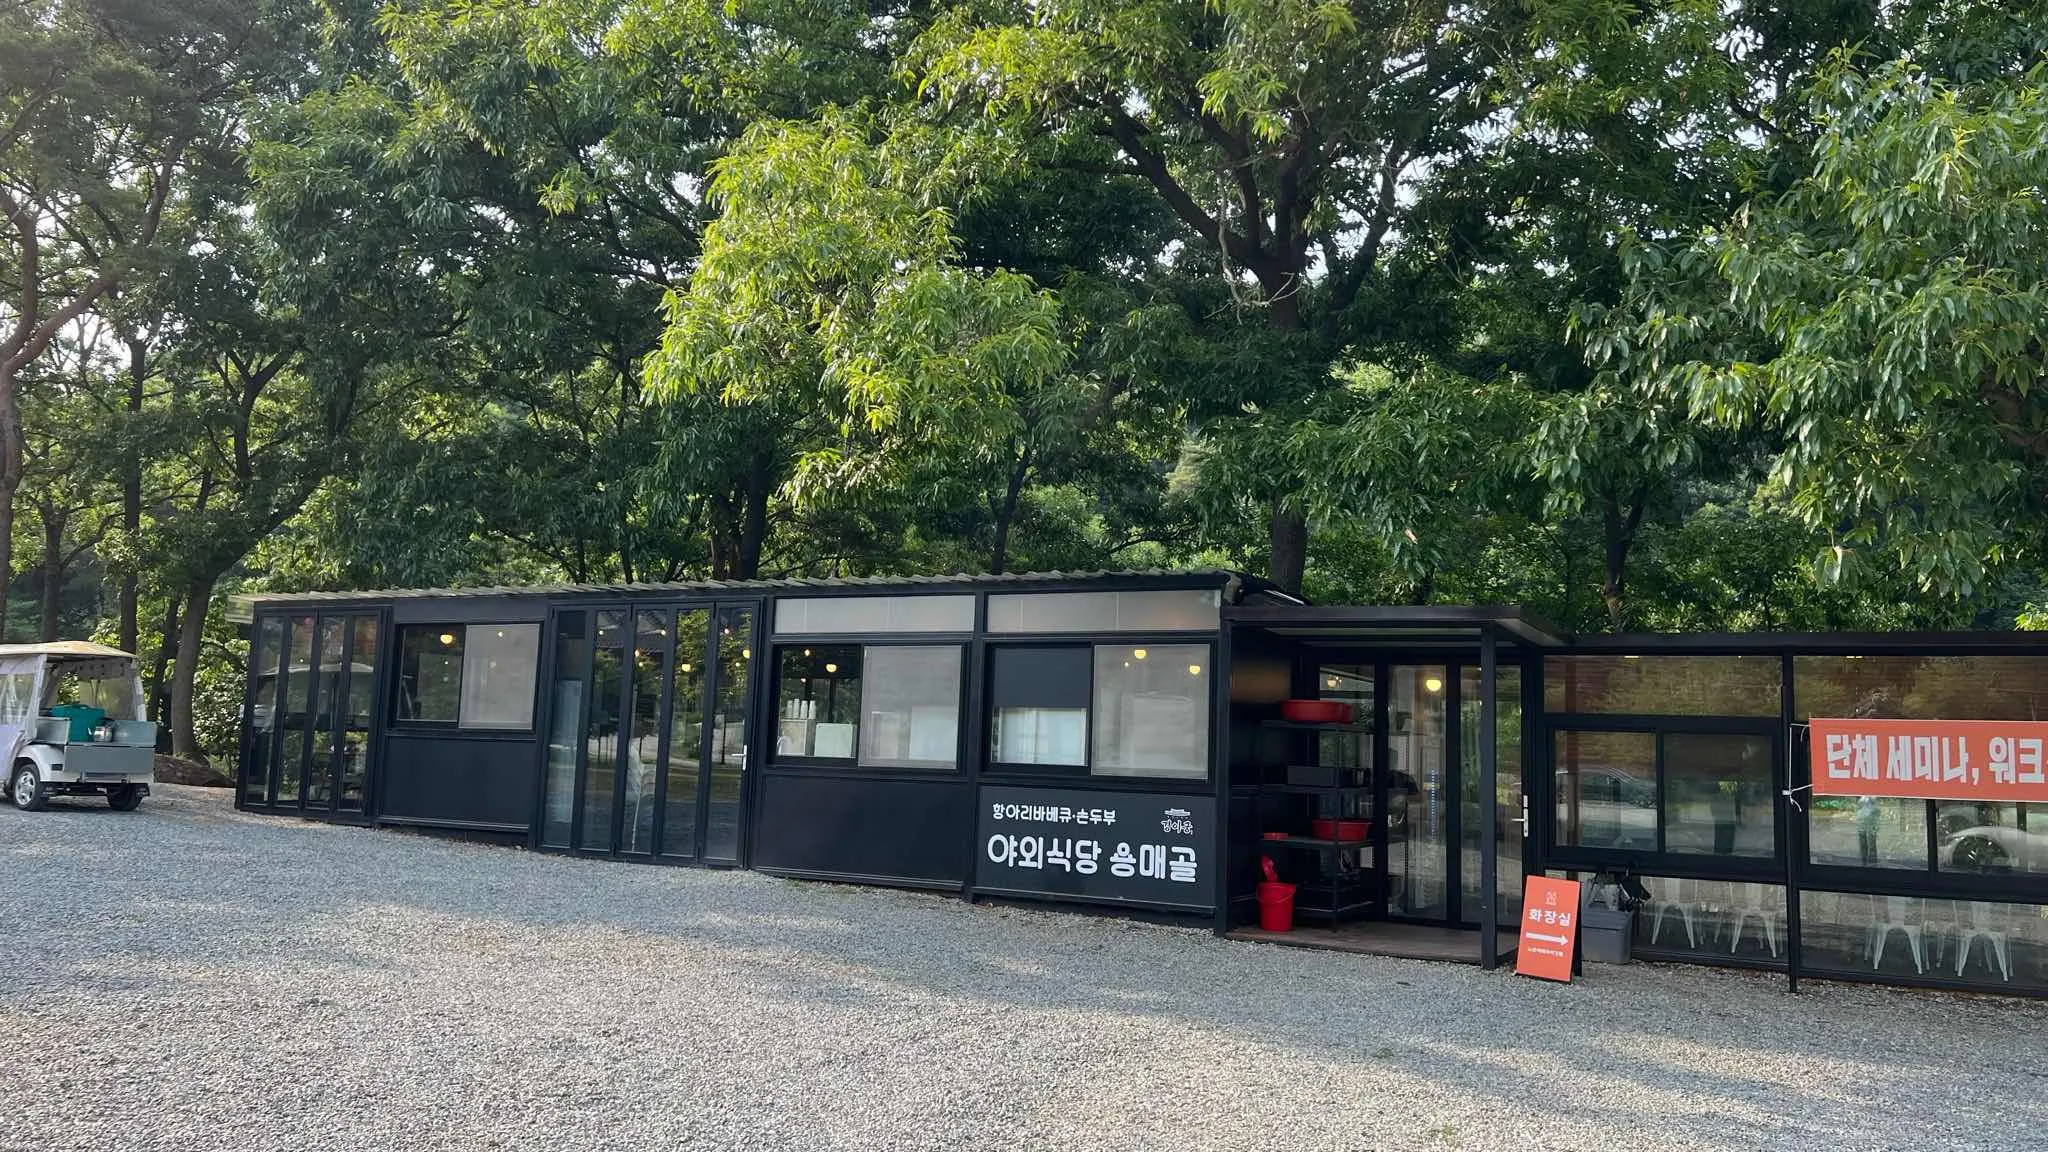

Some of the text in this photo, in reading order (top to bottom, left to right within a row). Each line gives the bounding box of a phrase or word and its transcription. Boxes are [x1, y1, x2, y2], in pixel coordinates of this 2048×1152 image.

[1825, 733, 2048, 785] 단체 세미나, 워크
[987, 833, 1198, 883] 야외식당 용매골
[1528, 908, 1571, 927] 화장실
